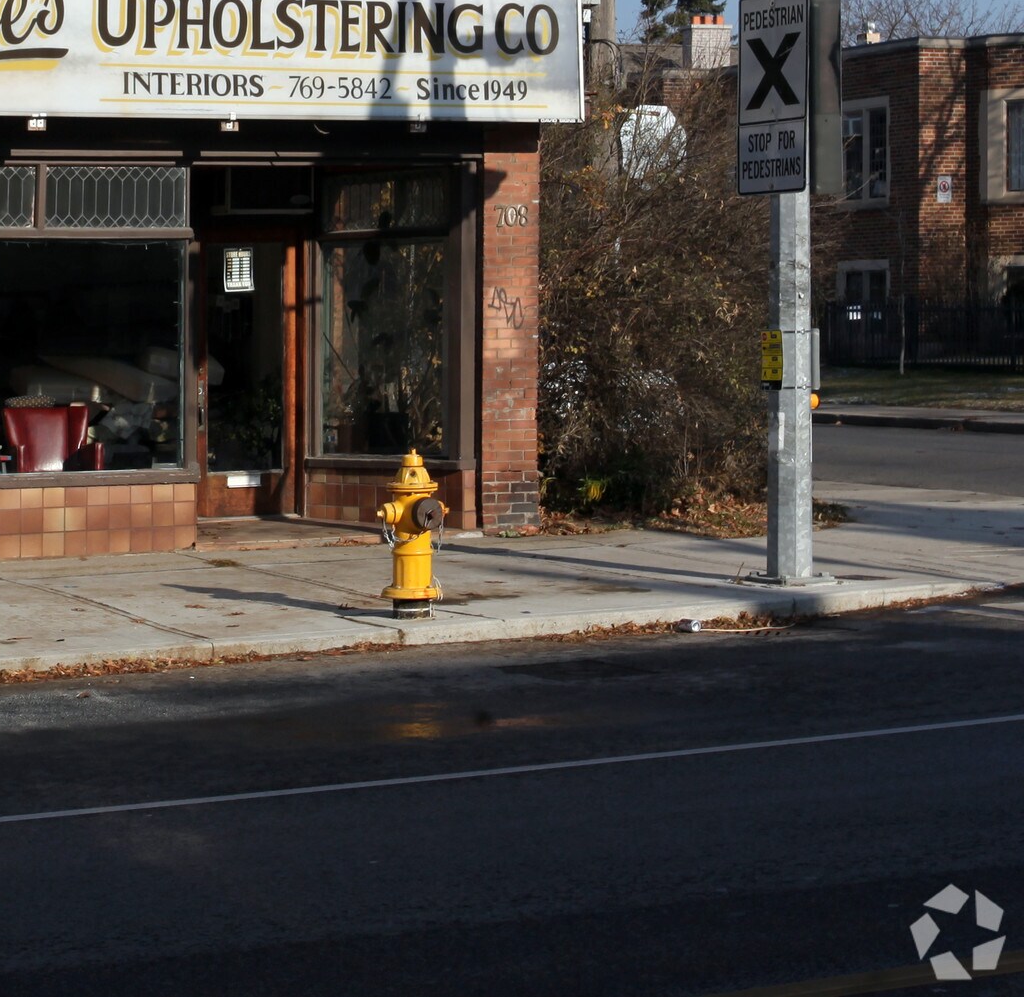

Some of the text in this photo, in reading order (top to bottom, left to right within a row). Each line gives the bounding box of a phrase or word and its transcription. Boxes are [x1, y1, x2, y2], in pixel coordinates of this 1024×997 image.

[495, 2, 560, 56] CO
[743, 3, 804, 32] PEDESTRIAN
[122, 70, 264, 97] INTERIORS
[288, 75, 393, 101] 769-5842
[745, 31, 802, 111] X
[748, 129, 796, 153] STOP FOR
[742, 156, 801, 180] PEDESTRIANS
[493, 204, 528, 227] 708
